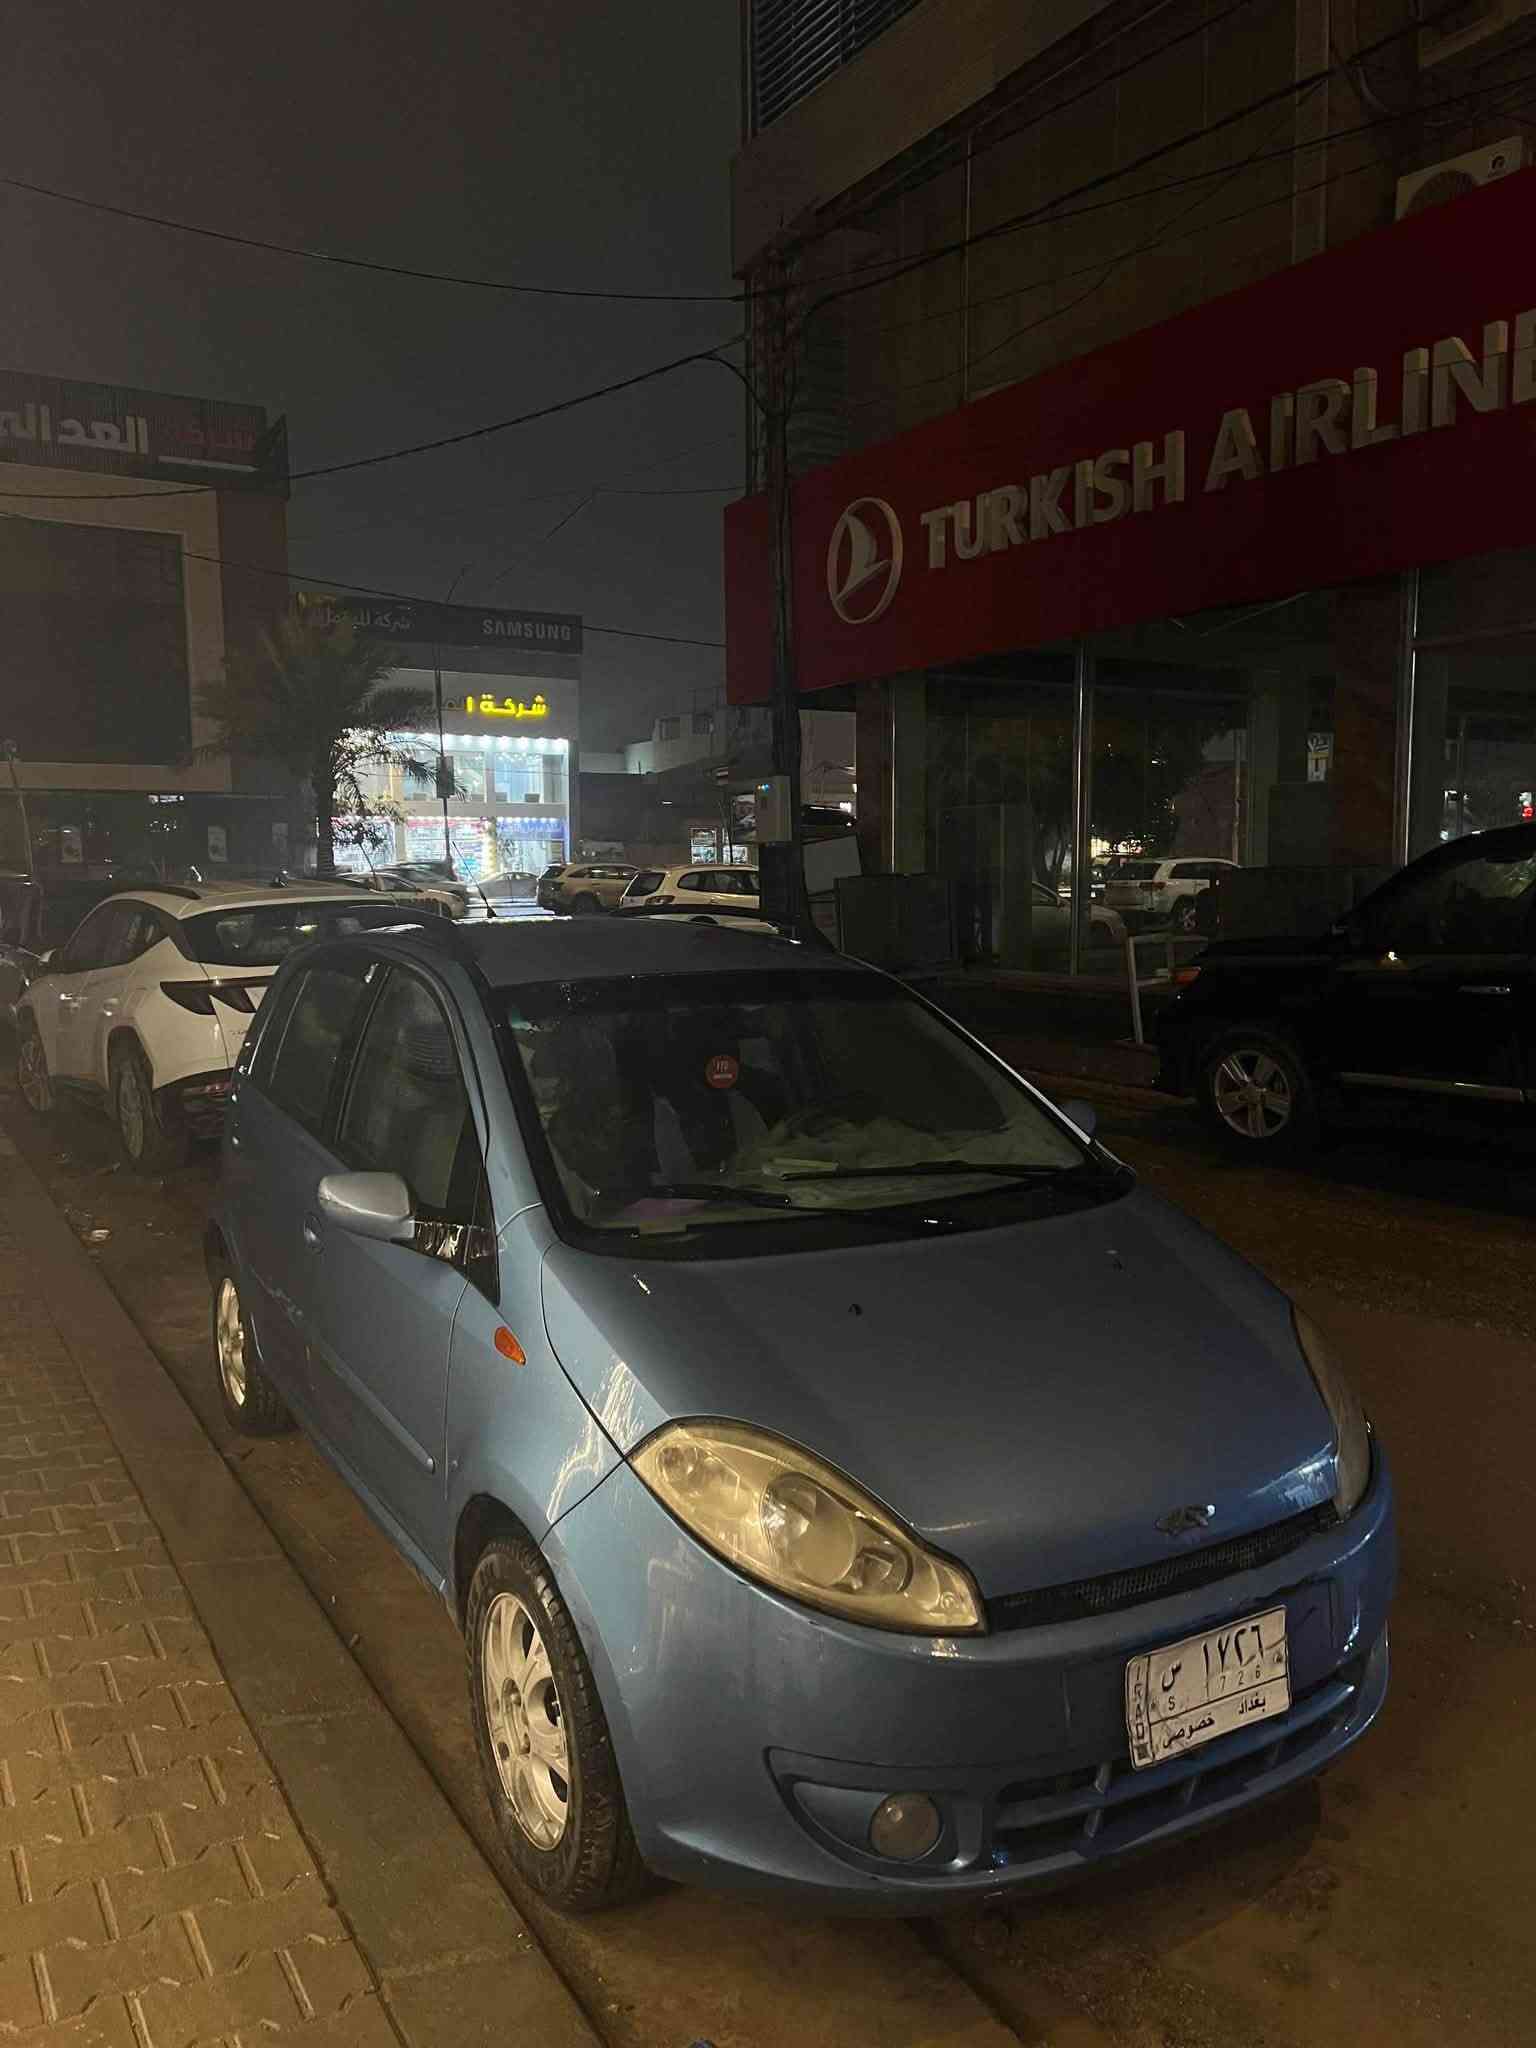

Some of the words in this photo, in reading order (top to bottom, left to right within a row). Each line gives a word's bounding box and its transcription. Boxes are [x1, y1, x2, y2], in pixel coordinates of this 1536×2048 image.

[920, 429, 1186, 569] TURKISH
[481, 618, 572, 641] SAMSUNG
[479, 692, 547, 718] شركة
[1161, 1661, 1182, 1693] س
[1202, 1623, 1265, 1680] ١٧٢٦
[1168, 1696, 1176, 1711] S
[1238, 1691, 1266, 1715] بغداد
